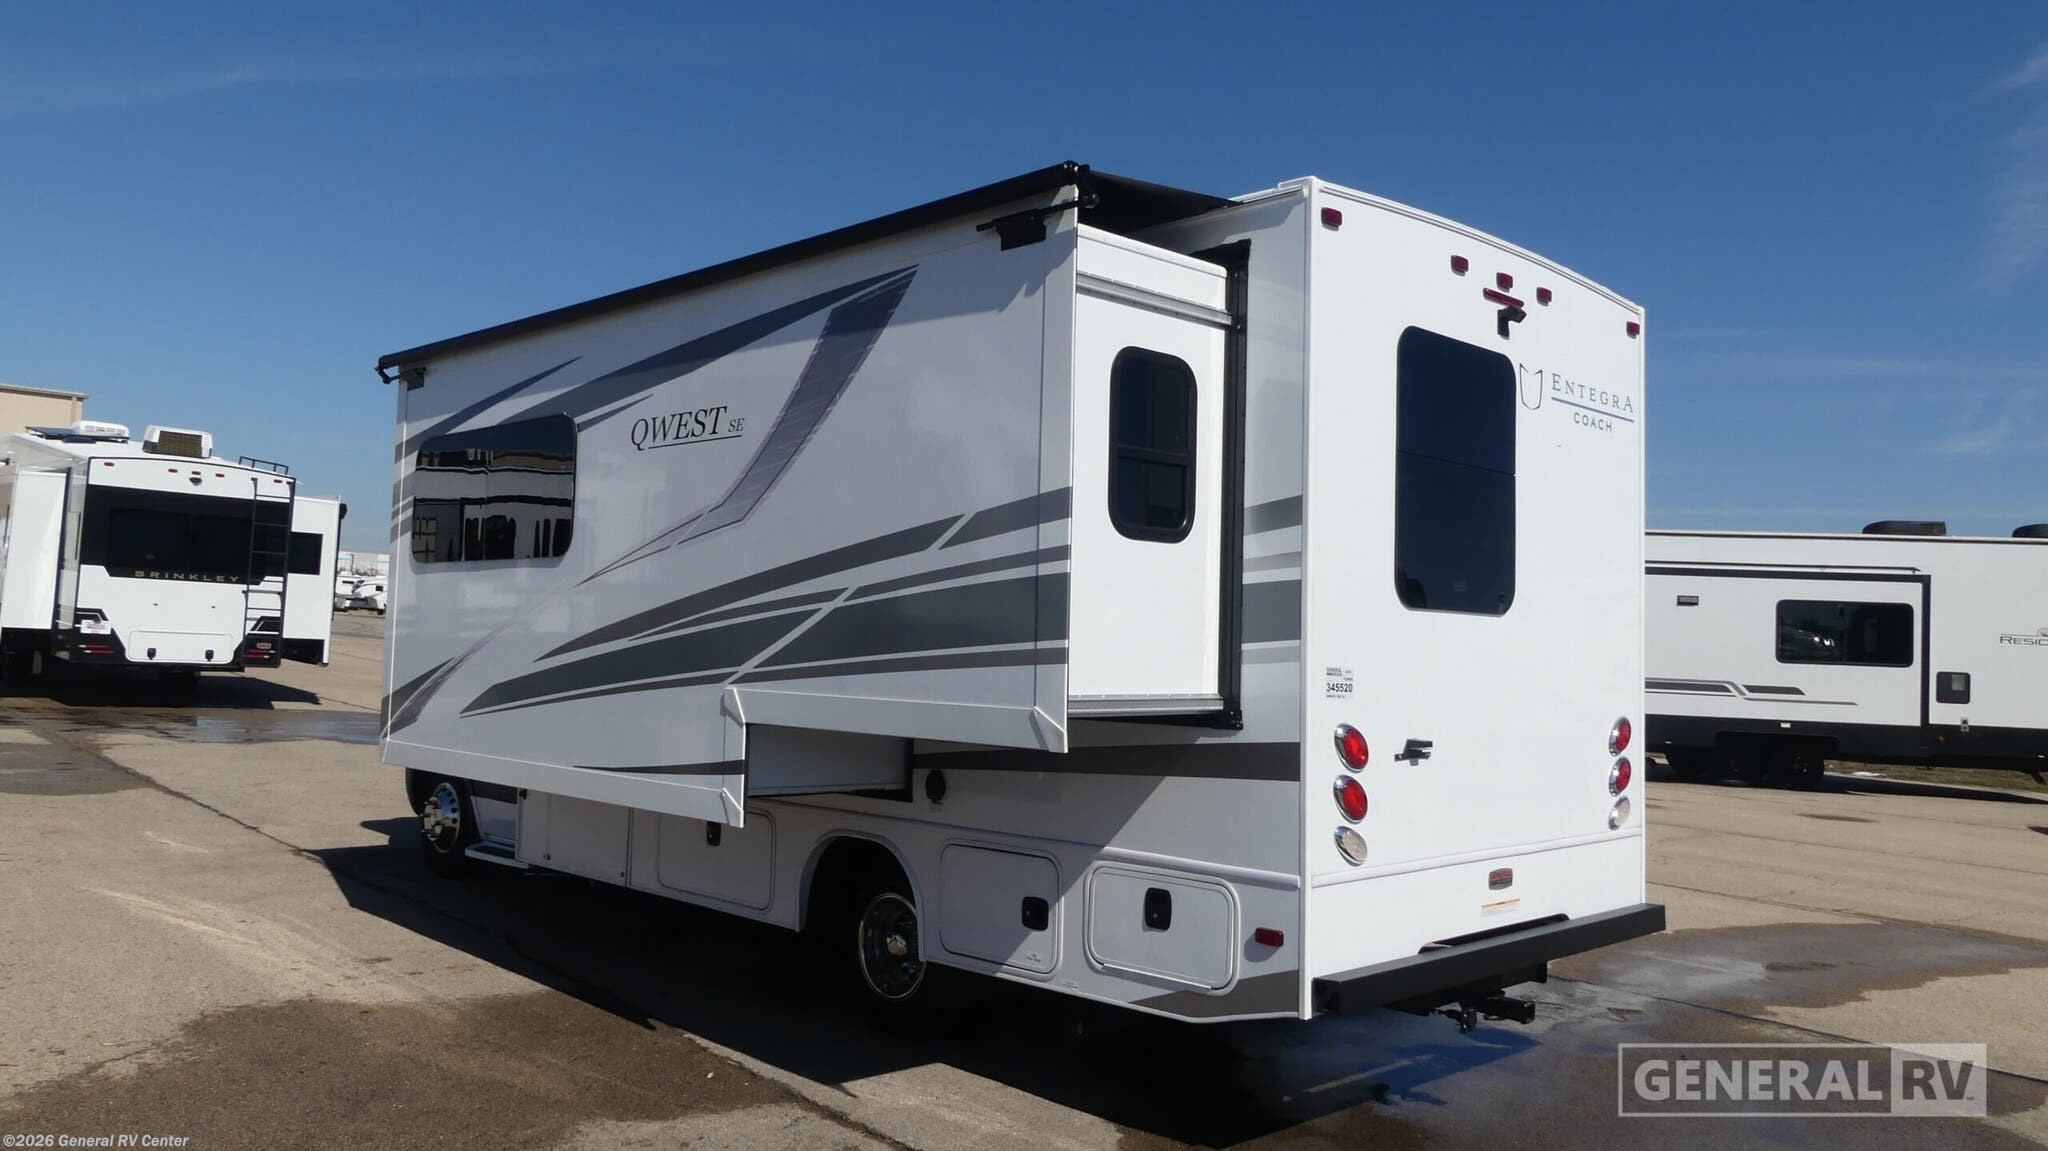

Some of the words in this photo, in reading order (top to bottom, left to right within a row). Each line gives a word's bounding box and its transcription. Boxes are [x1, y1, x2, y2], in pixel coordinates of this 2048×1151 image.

[1551, 372, 1634, 413] ENTEGRA
[631, 405, 728, 451] QWEST
[728, 417, 745, 433] SE
[1573, 411, 1613, 433] COACH
[134, 570, 240, 583] BRINKLEY
[1326, 682, 1353, 693] 345520
